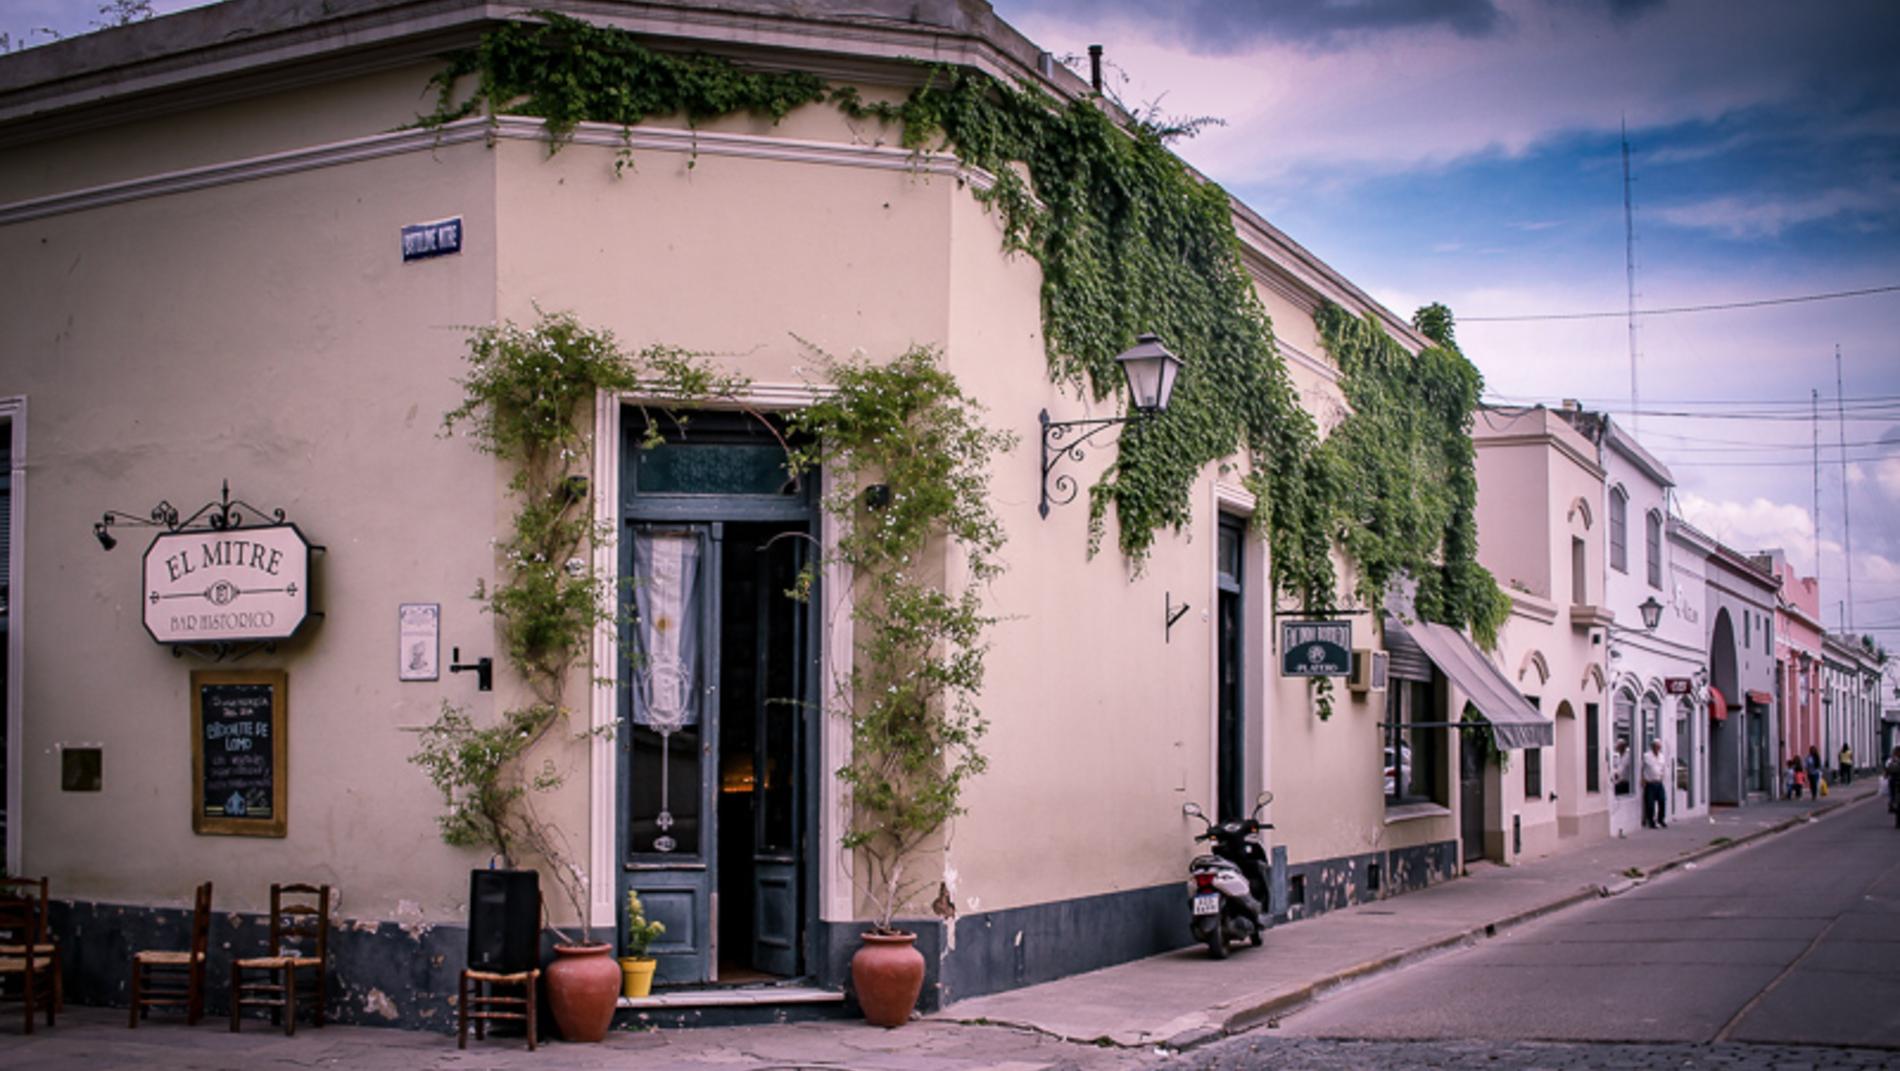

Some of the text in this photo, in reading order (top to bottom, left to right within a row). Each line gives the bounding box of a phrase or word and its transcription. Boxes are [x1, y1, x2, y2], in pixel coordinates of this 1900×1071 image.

[165, 541, 284, 583] EL MITRE
[170, 614, 198, 632] BAR
